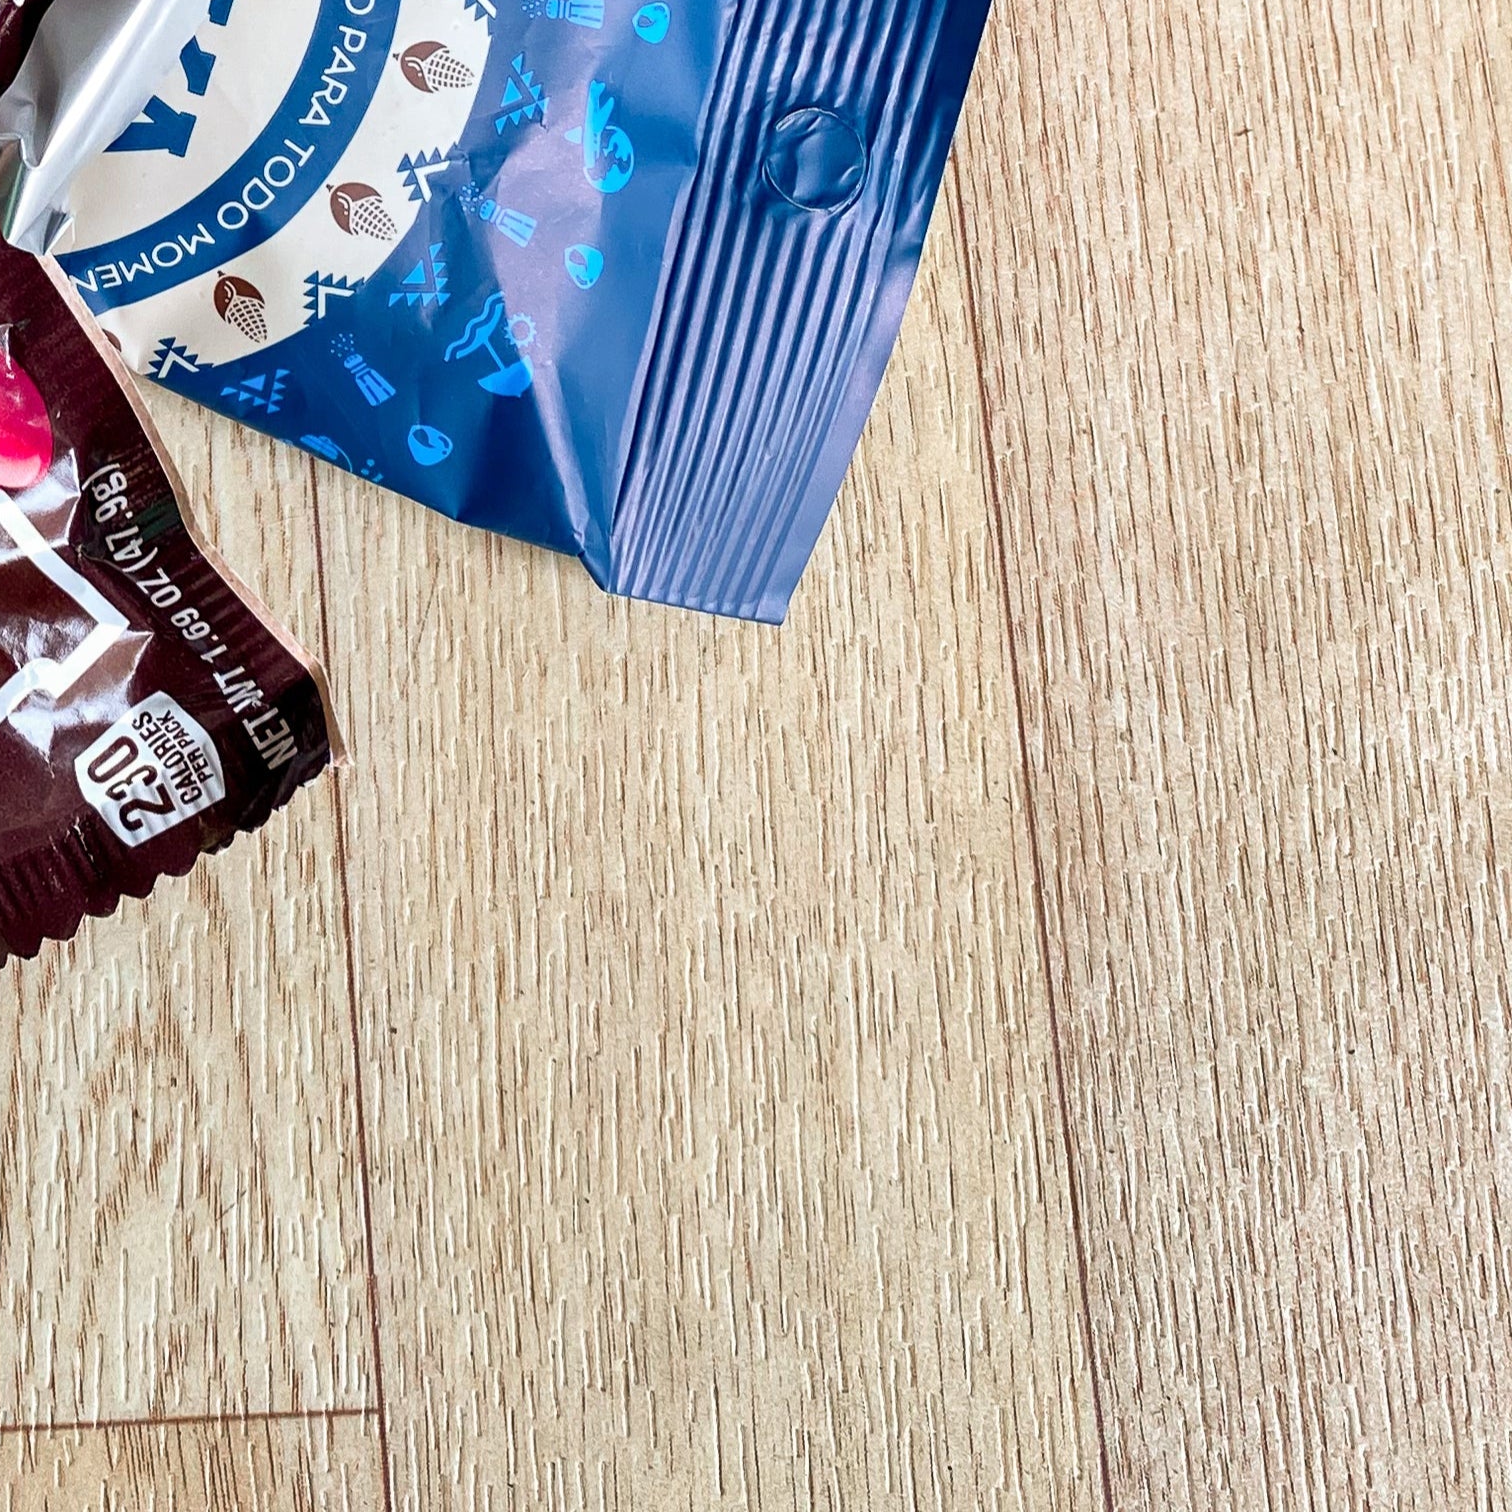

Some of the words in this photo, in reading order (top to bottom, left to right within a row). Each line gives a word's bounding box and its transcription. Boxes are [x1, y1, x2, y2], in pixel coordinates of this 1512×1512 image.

[298, 24, 368, 127] PARA
[216, 138, 316, 230] TODO
[80, 462, 158, 574] (47.9g)
[136, 567, 183, 609] OZ
[170, 606, 228, 665] 1.69
[212, 665, 265, 715] WT
[131, 710, 203, 806] CALORIES
[156, 709, 195, 749] PACK
[242, 706, 299, 771] NET
[87, 735, 176, 832] 230
[186, 746, 214, 785] PER
